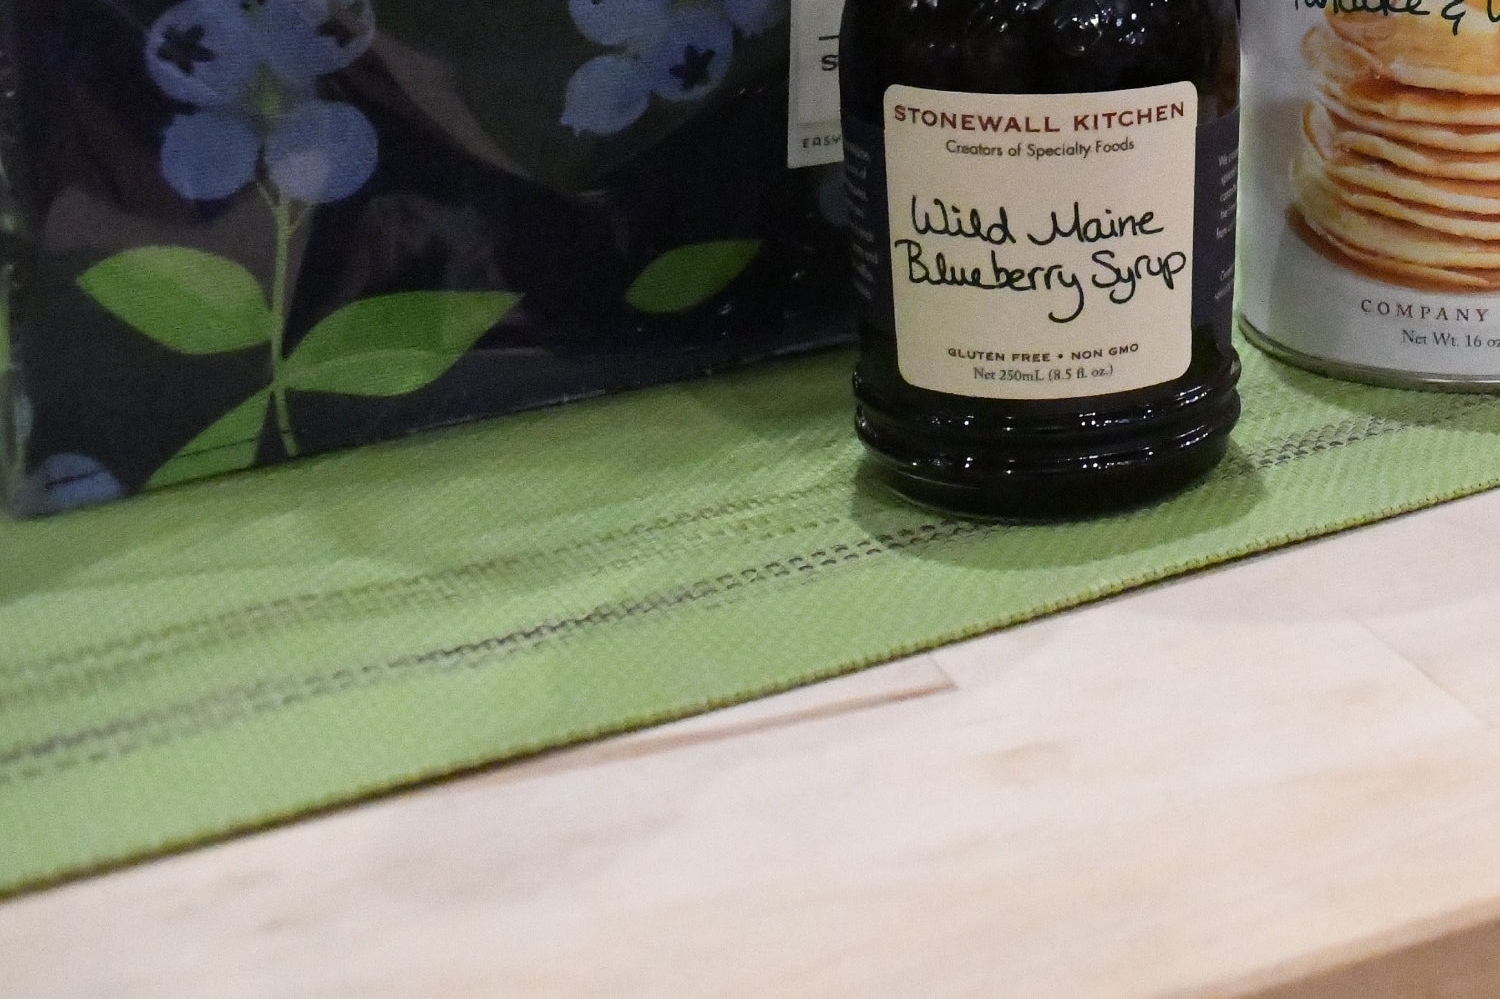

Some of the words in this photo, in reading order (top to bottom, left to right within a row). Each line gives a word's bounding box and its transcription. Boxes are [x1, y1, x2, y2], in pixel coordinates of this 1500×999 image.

[894, 104, 1060, 133] STONEWALL
[1073, 101, 1185, 132] KITCHEN
[945, 140, 1003, 156] Creators
[1008, 141, 1023, 156] of
[1027, 139, 1092, 160] Specialty
[1096, 137, 1135, 153] Foods
[911, 195, 1017, 245] Wild
[1027, 201, 1165, 246] Maine
[895, 239, 1085, 323] Blueberry
[1091, 250, 1186, 304] Syrup
[1361, 299, 1490, 322] COMPANY
[1402, 329, 1429, 345] Net
[1433, 331, 1459, 347] Wt.
[1465, 334, 1482, 347] 16
[947, 347, 1006, 363] GLUTEN
[1011, 352, 1052, 363] FREE
[1071, 349, 1103, 361] NON
[1108, 343, 1139, 358] GMO
[973, 367, 996, 381] Net
[999, 368, 1045, 382] 250mL
[1091, 365, 1115, 379] oz.)
